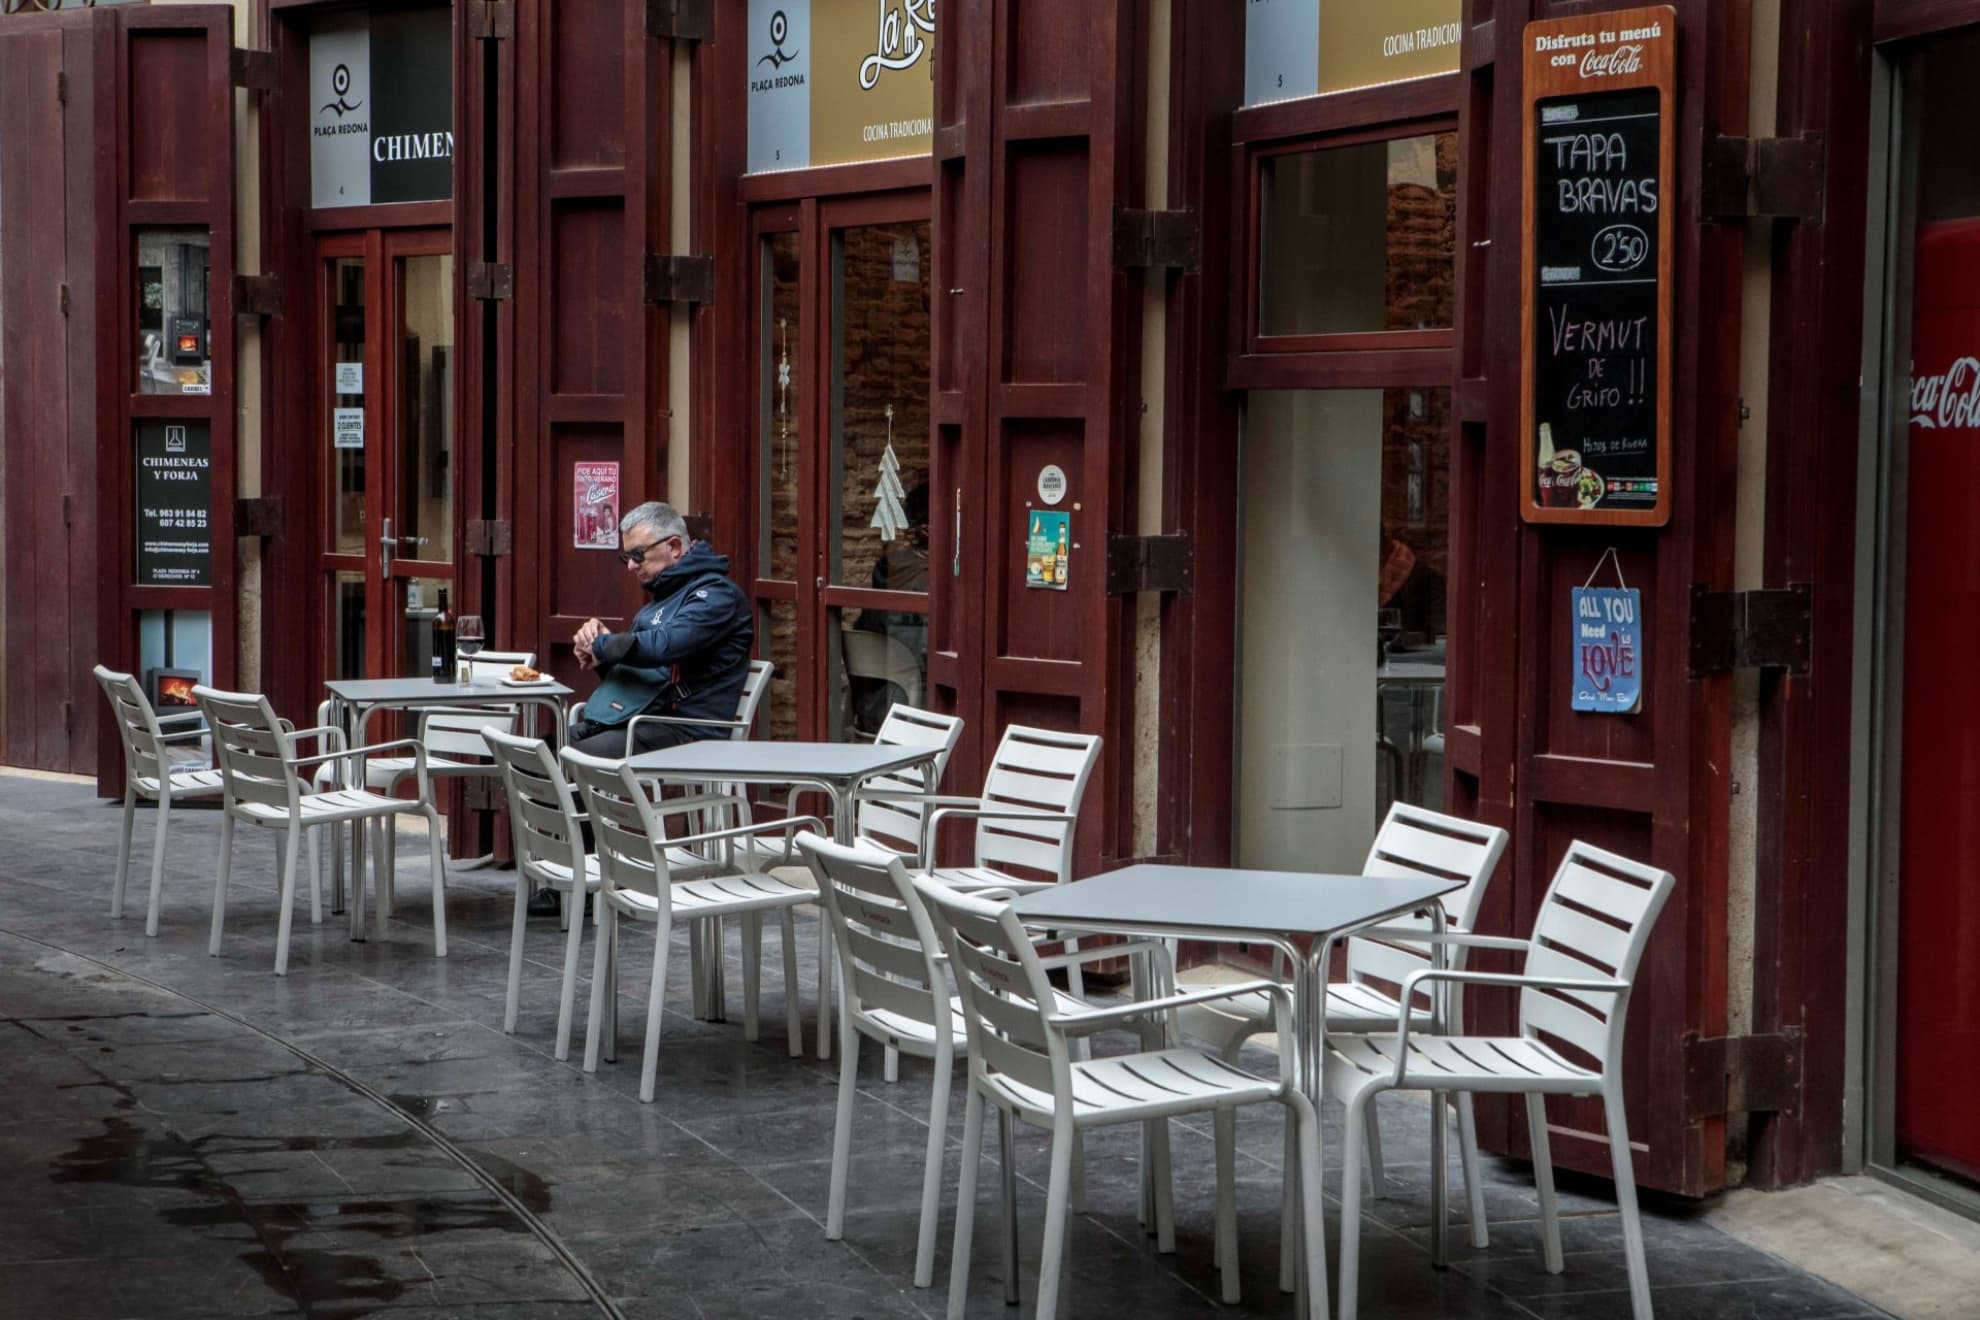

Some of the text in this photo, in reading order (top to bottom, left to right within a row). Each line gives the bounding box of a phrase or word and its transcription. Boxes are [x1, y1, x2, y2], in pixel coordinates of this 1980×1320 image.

[1383, 31, 1414, 57] COCINA
[1535, 21, 1662, 52] Disfruta tu menú
[1551, 44, 1644, 79] con Coca-Cola
[751, 74, 805, 94] PLAÇA REDONA
[1277, 74, 1283, 89] 5
[314, 123, 368, 138] PLAÇA REDONA
[863, 122, 888, 142] COCINA
[775, 150, 780, 160] 5
[1543, 132, 1626, 172] TAPA
[1558, 177, 1657, 214] BRAVAS
[1549, 303, 1647, 356] VERMUT
[1588, 358, 1605, 379] DE
[143, 457, 209, 468] CHIMENEAS
[608, 467, 616, 475] TU
[153, 470, 198, 480] Y FORJA
[144, 508, 158, 517] Tel.
[175, 508, 184, 518] 91
[160, 519, 173, 527] 607
[175, 519, 185, 527] 42
[197, 519, 207, 527] 23
[1580, 596, 1634, 624] ALL YOU
[1581, 624, 1605, 638] Need
[1580, 631, 1634, 692] LOVE
